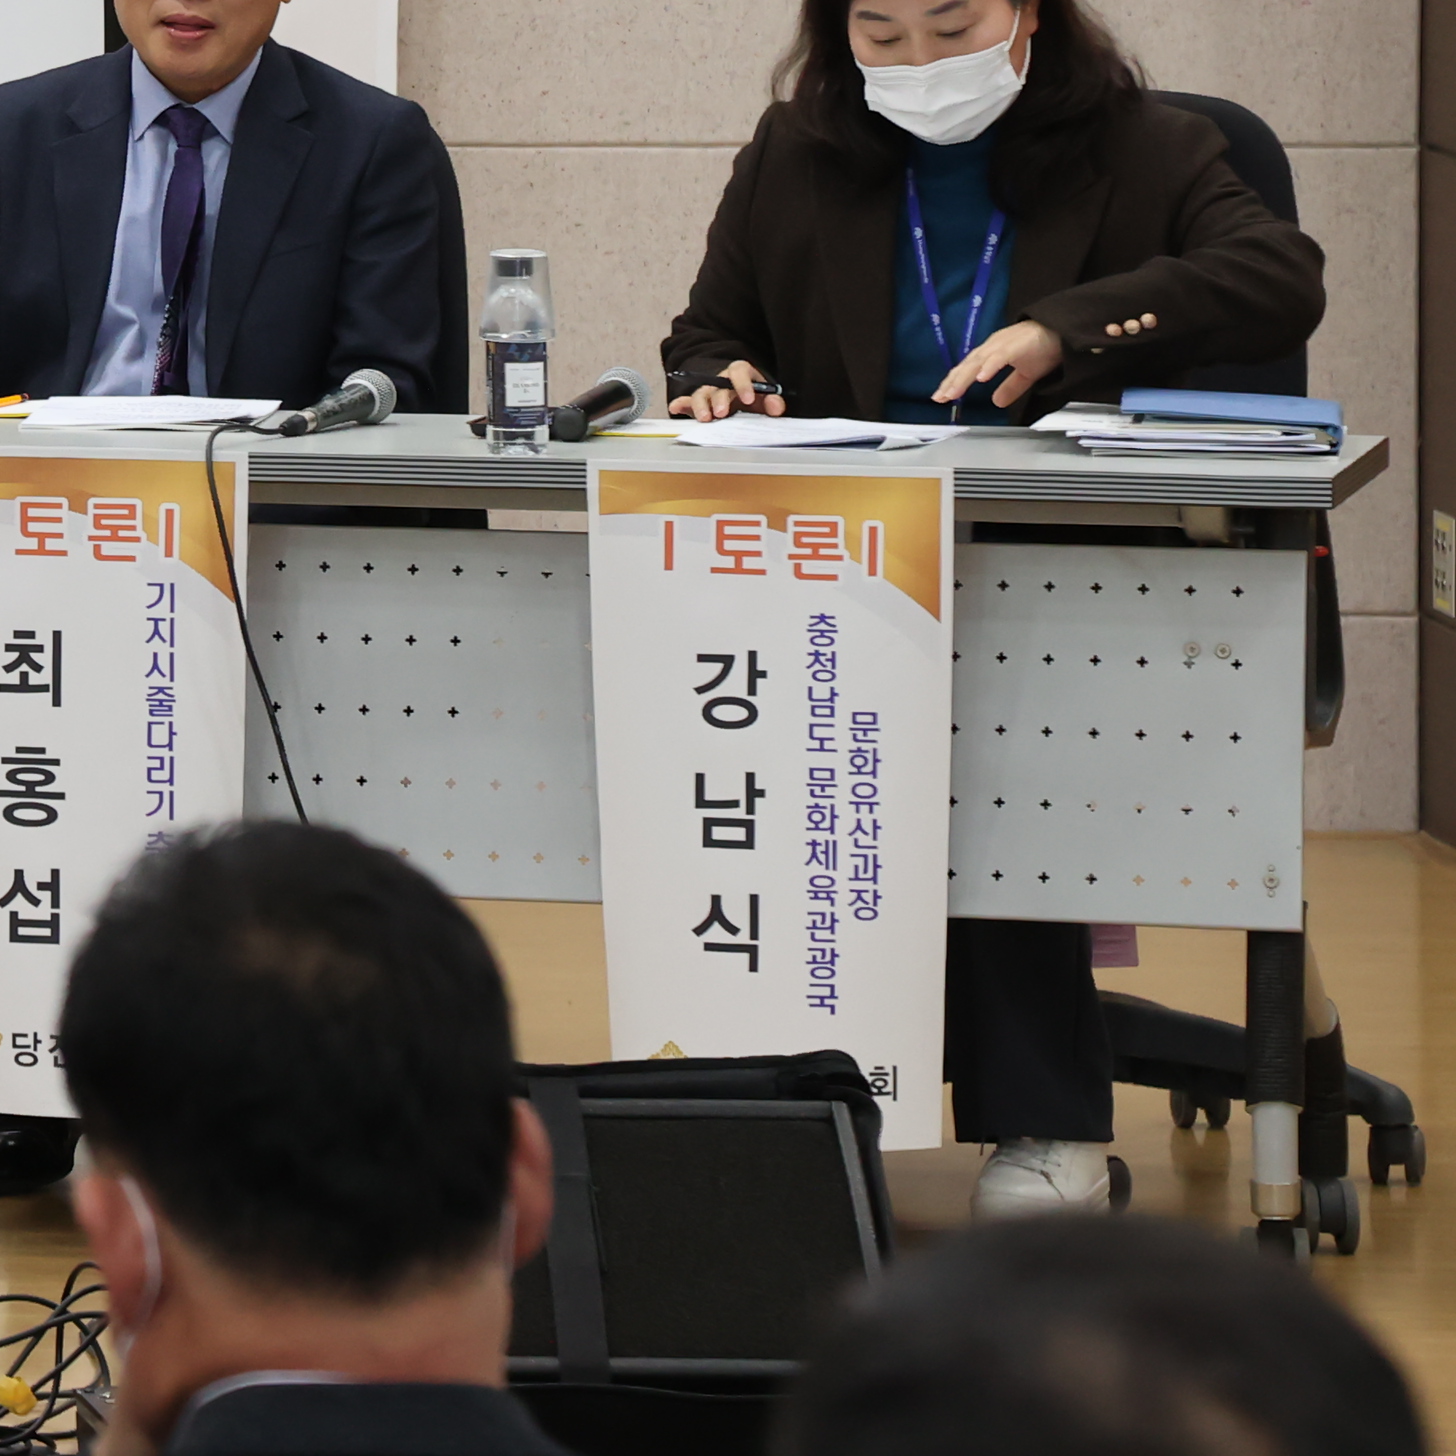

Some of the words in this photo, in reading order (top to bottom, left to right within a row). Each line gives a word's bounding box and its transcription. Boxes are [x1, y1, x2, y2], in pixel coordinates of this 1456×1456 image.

[14, 503, 142, 563] 토론
[709, 520, 846, 582] 토론
[144, 582, 179, 822] 기지시줄다리기
[806, 612, 841, 754] 충청남도
[804, 767, 841, 1017] 문화체육관광국
[848, 711, 884, 923] 문화유산과장
